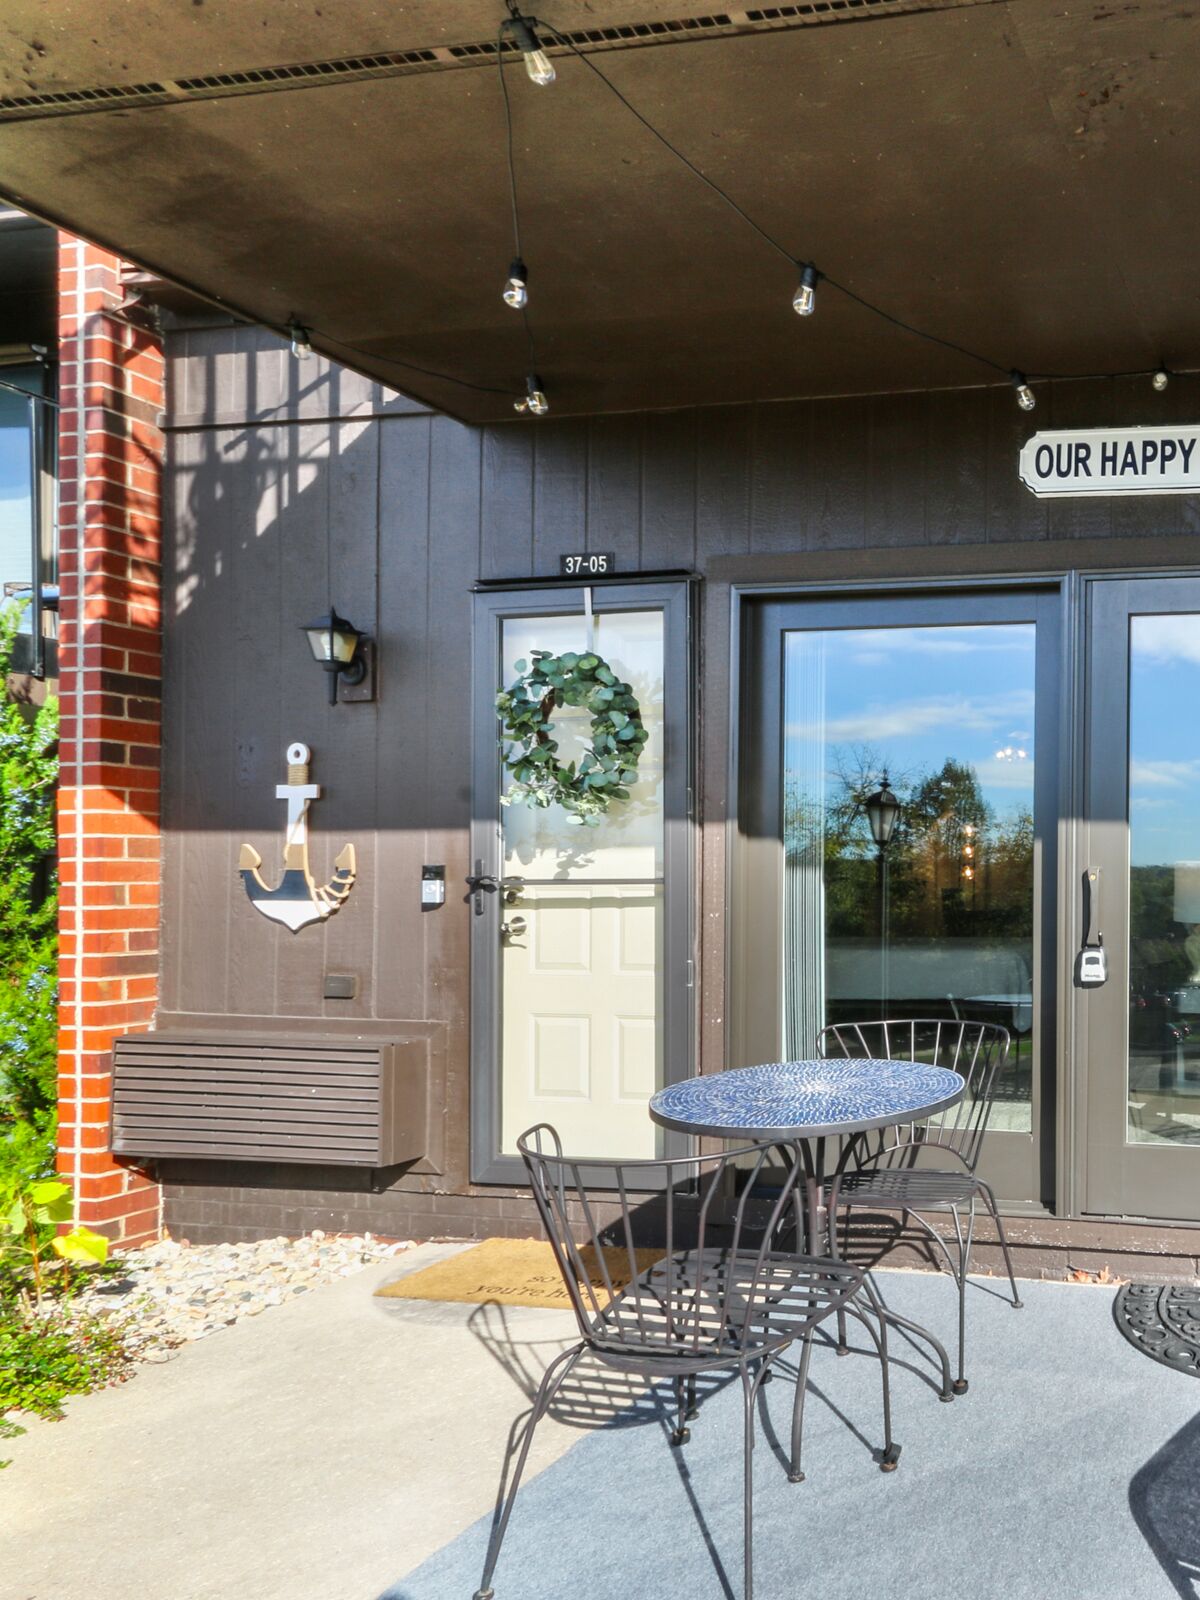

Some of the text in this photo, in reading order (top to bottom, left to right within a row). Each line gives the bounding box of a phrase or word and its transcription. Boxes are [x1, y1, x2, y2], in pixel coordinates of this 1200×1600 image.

[1035, 442, 1092, 479] OUR
[1100, 438, 1197, 476] HAPPY
[565, 555, 607, 574] 37-05
[466, 1285, 545, 1297] you're
